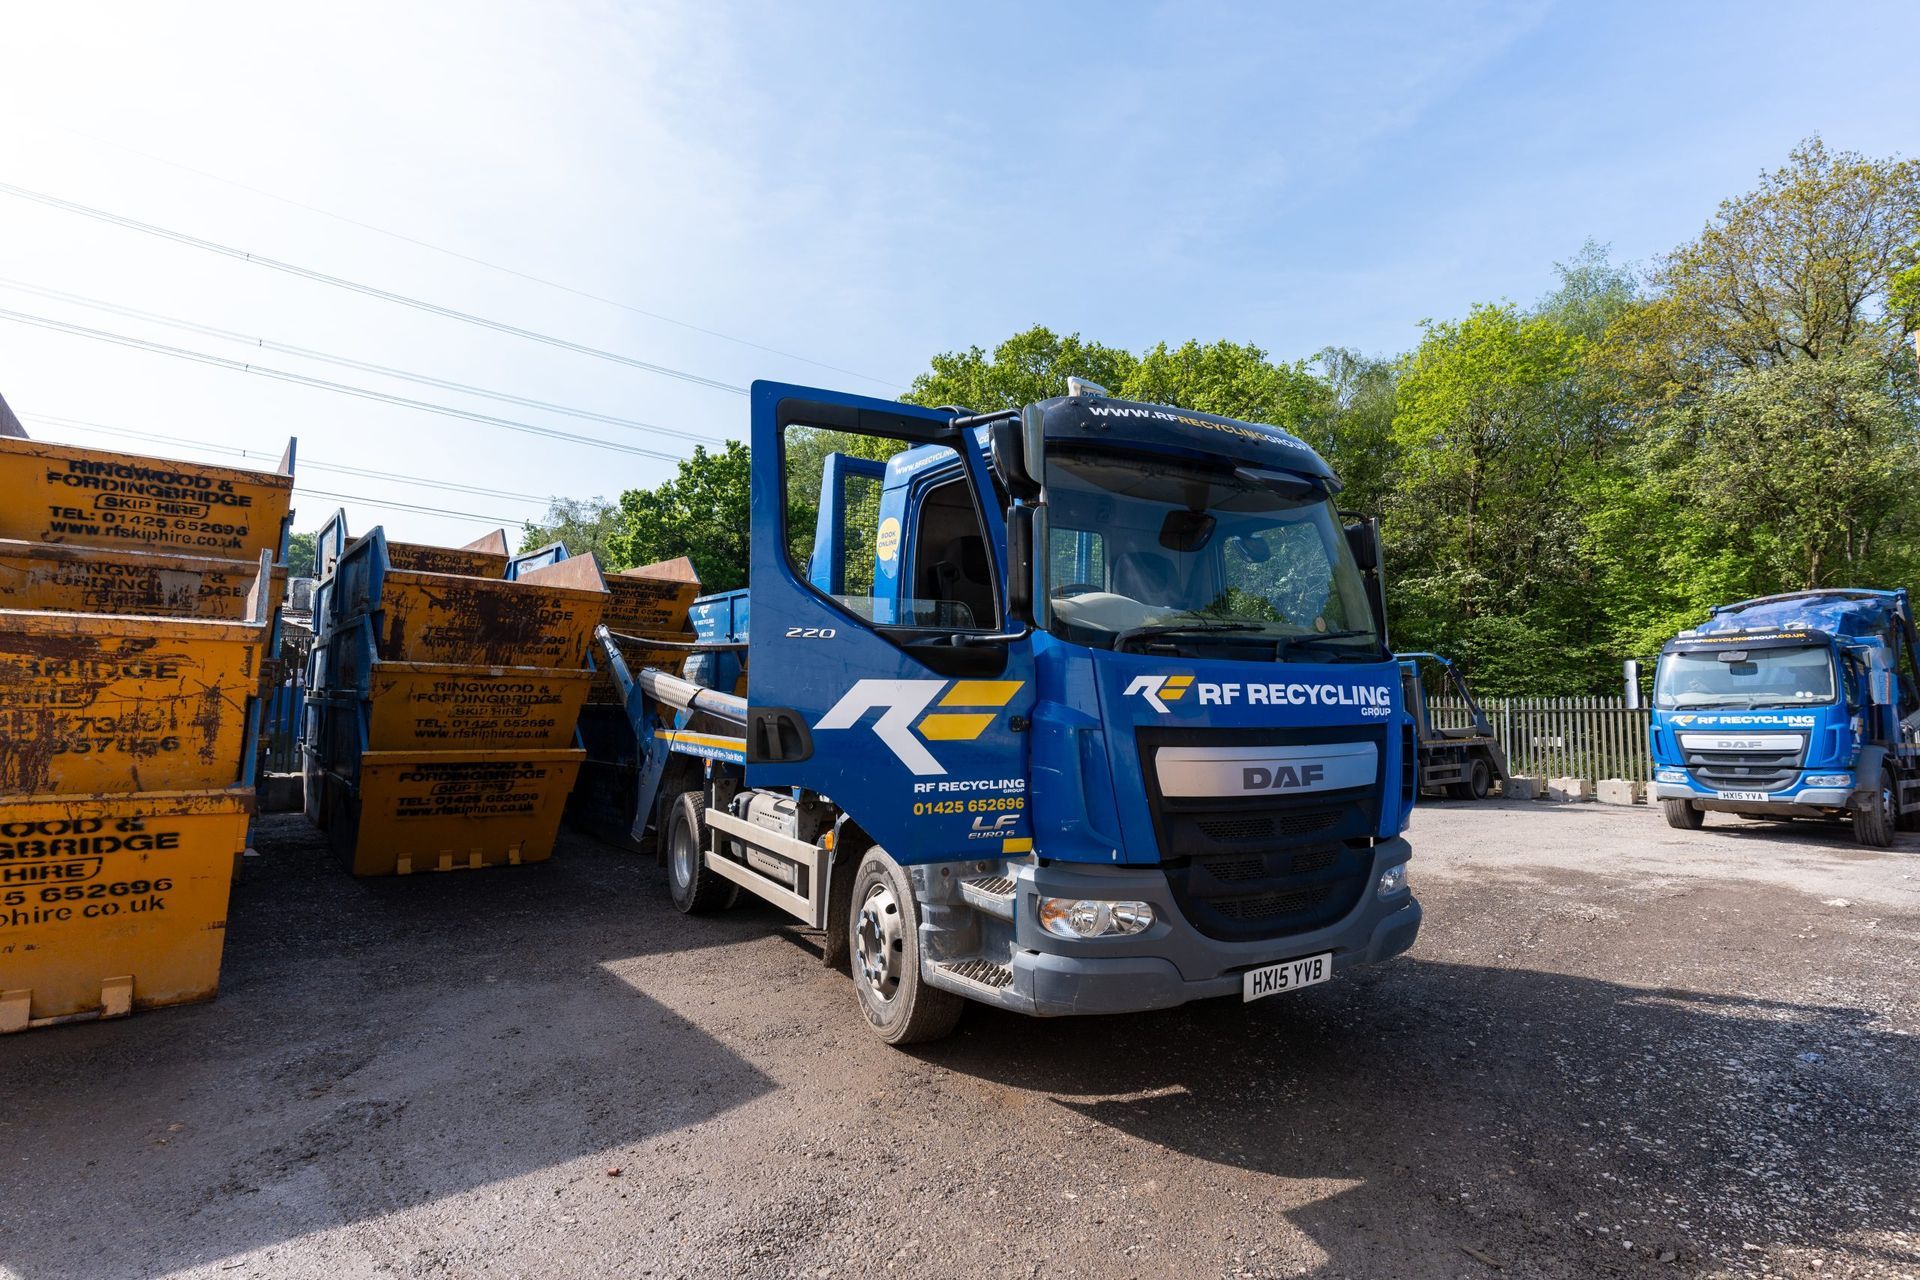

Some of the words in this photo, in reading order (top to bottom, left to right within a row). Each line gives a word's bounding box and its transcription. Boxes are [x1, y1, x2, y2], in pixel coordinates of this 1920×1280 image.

[68, 459, 213, 489] RINGWOOD
[218, 480, 235, 493] &
[46, 471, 253, 507] FORDINGBRIDGE
[103, 496, 151, 510] SKIP
[156, 502, 201, 517] HIRE
[49, 506, 96, 521] TEL:
[101, 512, 168, 529] 01425
[174, 519, 249, 537] 652696
[881, 530, 896, 539] BOOK
[878, 539, 897, 547] ONLINE
[784, 626, 837, 639] 220
[433, 682, 534, 694] RINGWOOD
[539, 685, 550, 694] &
[1198, 683, 1241, 705] RF
[1248, 683, 1391, 706] RECYCLING
[455, 706, 488, 716] SKIP
[491, 707, 524, 716] HIRE
[1360, 707, 1392, 717] GROUP
[415, 718, 448, 729] TEL:
[452, 718, 498, 728] 01425
[503, 718, 556, 728] 652696
[1697, 716, 1718, 725] RF
[1720, 715, 1815, 725] RECYCLING
[1717, 740, 1762, 749] DAF
[398, 768, 546, 783] FORDINGBRIDGE
[1242, 764, 1324, 790] DAF
[438, 784, 471, 794] SKIP
[913, 782, 936, 793] RF
[938, 778, 1025, 793] RECYCLING
[1722, 792, 1744, 800] HX15
[1745, 792, 1763, 800] YVA
[913, 800, 964, 816] 01425
[967, 796, 1025, 813] 652696
[971, 814, 1021, 831] LF
[968, 829, 1005, 840] EURO
[1005, 829, 1016, 837] 6
[3, 863, 86, 883] HIRE
[39, 877, 173, 903] 652696
[1252, 966, 1289, 996] HX15
[1294, 958, 1323, 985] YVB
